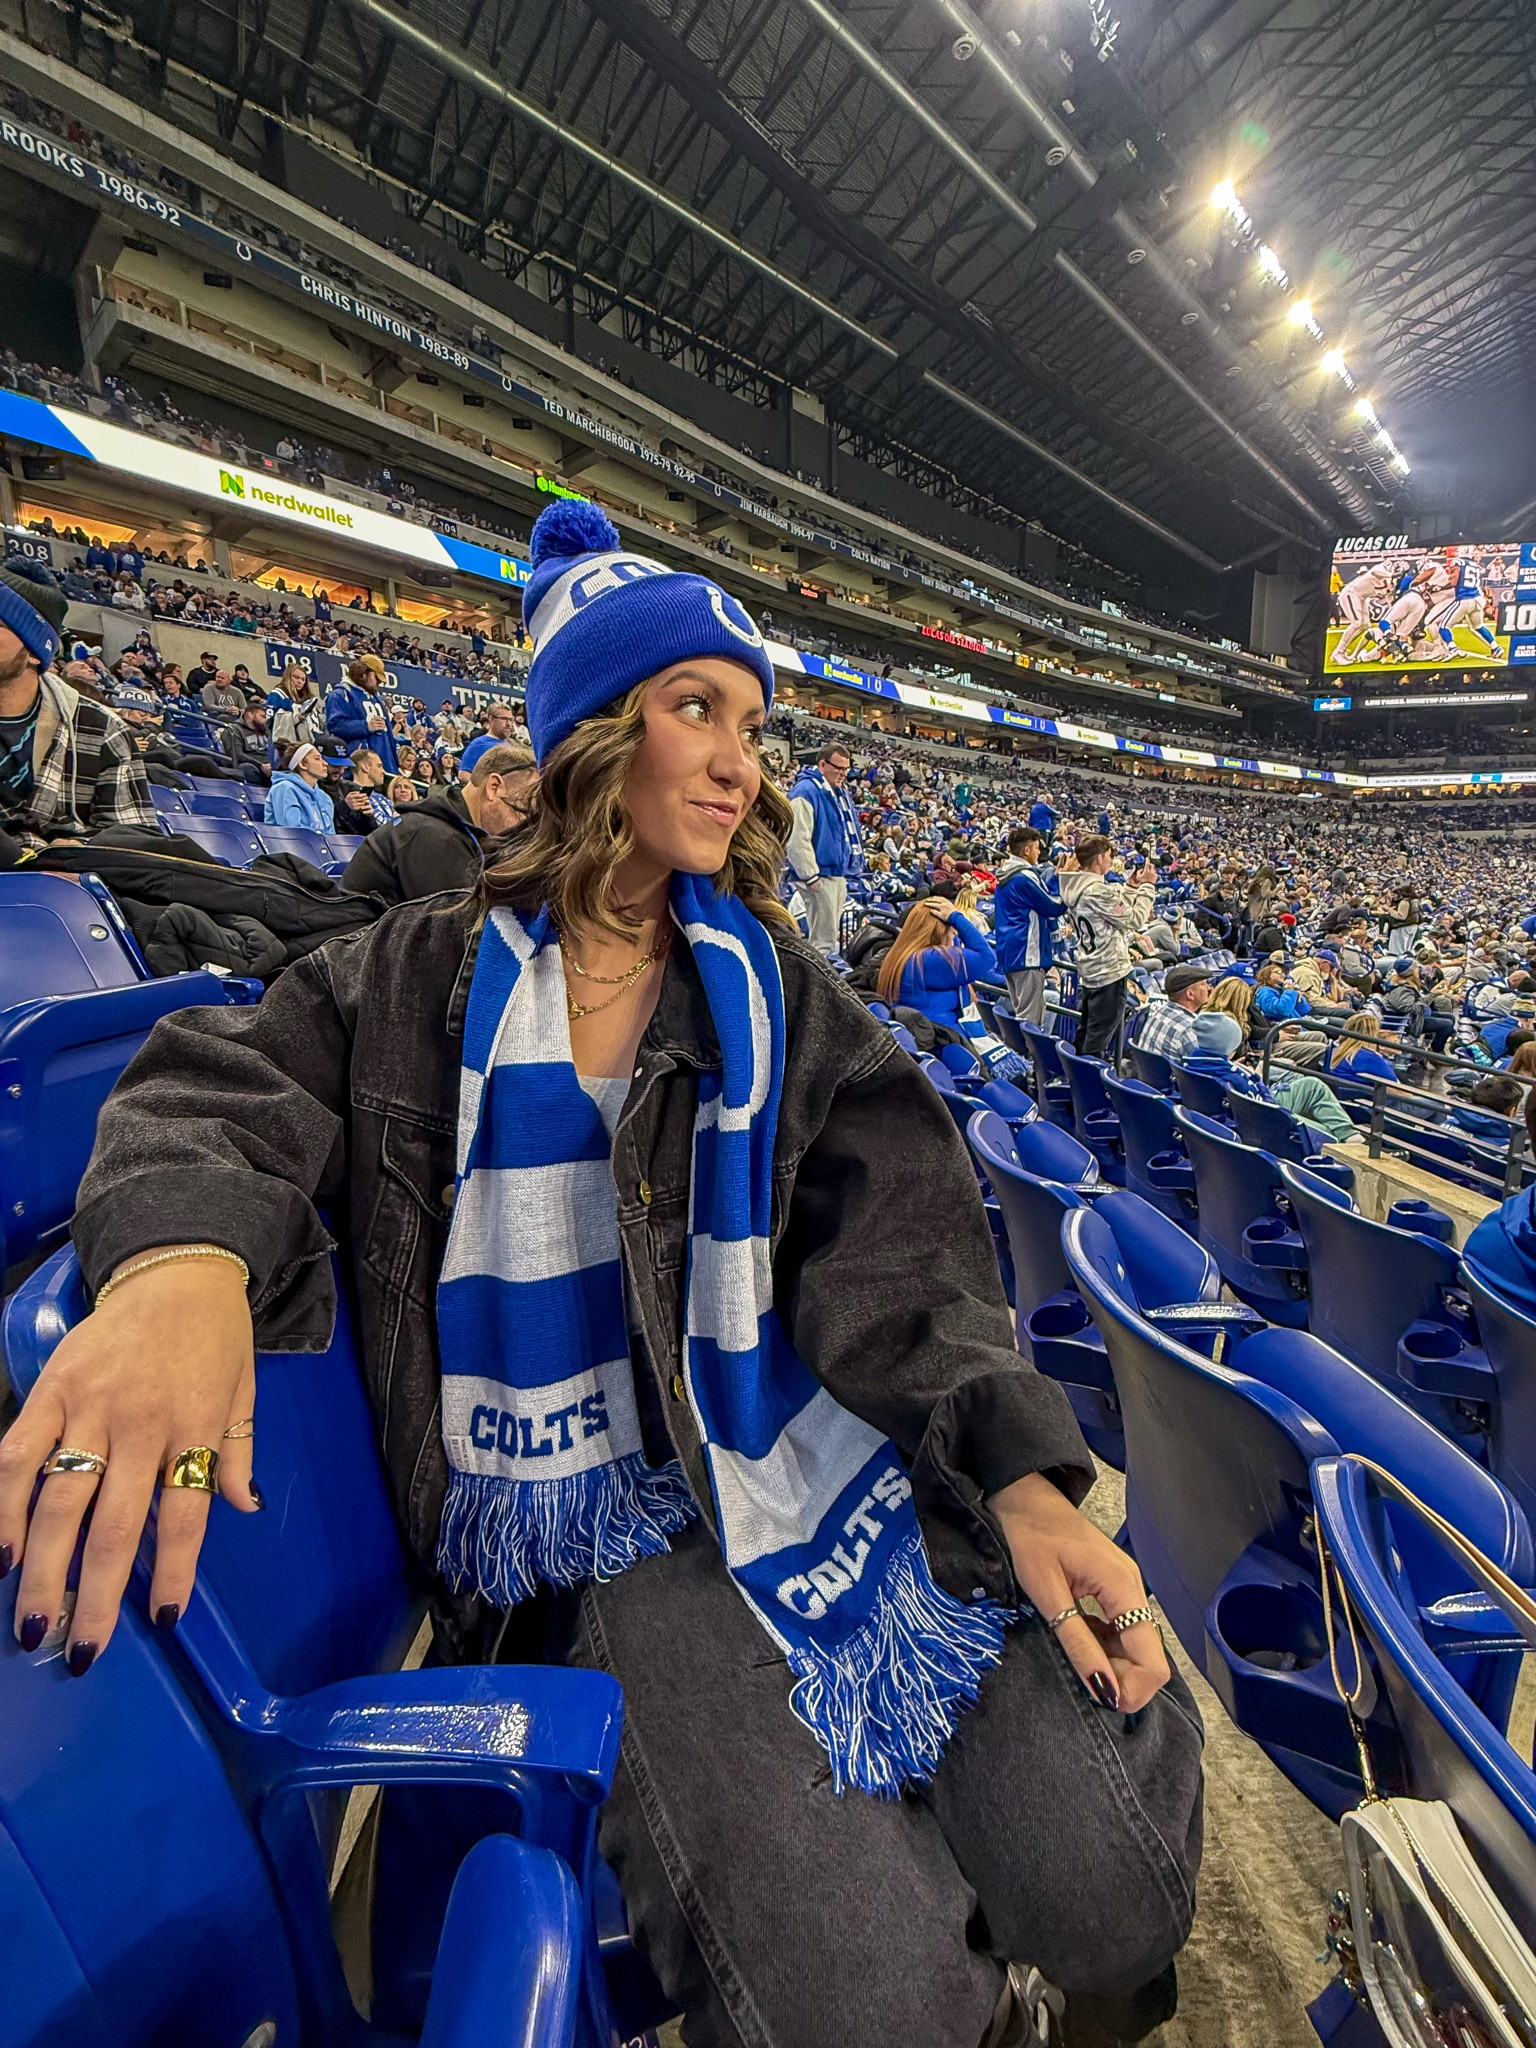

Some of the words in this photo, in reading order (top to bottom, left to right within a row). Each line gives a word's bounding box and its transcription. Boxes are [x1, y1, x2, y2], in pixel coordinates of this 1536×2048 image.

[0, 120, 85, 178] ROOKS
[97, 170, 182, 227] 1986-92
[301, 275, 351, 312] CHRIS
[355, 302, 412, 342] HINTON
[418, 334, 470, 371] 1983-89
[542, 397, 564, 418] TED
[566, 409, 636, 454] MARCHIBRODA
[673, 464, 696, 484] 92-95
[400, 482, 415, 494] 409
[250, 486, 354, 529] nerdwallet
[740, 498, 753, 513] JIM
[753, 505, 788, 530] HARBAUGH
[851, 548, 870, 563] COLTS
[1335, 536, 1383, 551] LUCAS
[1384, 535, 1409, 549] OIL
[1503, 604, 1536, 631] 10
[921, 625, 944, 641] LUCAS
[956, 637, 988, 654] STADIUM
[270, 651, 312, 675] 108
[469, 1389, 610, 1459] COLTS
[775, 1466, 913, 1621] COLTS
